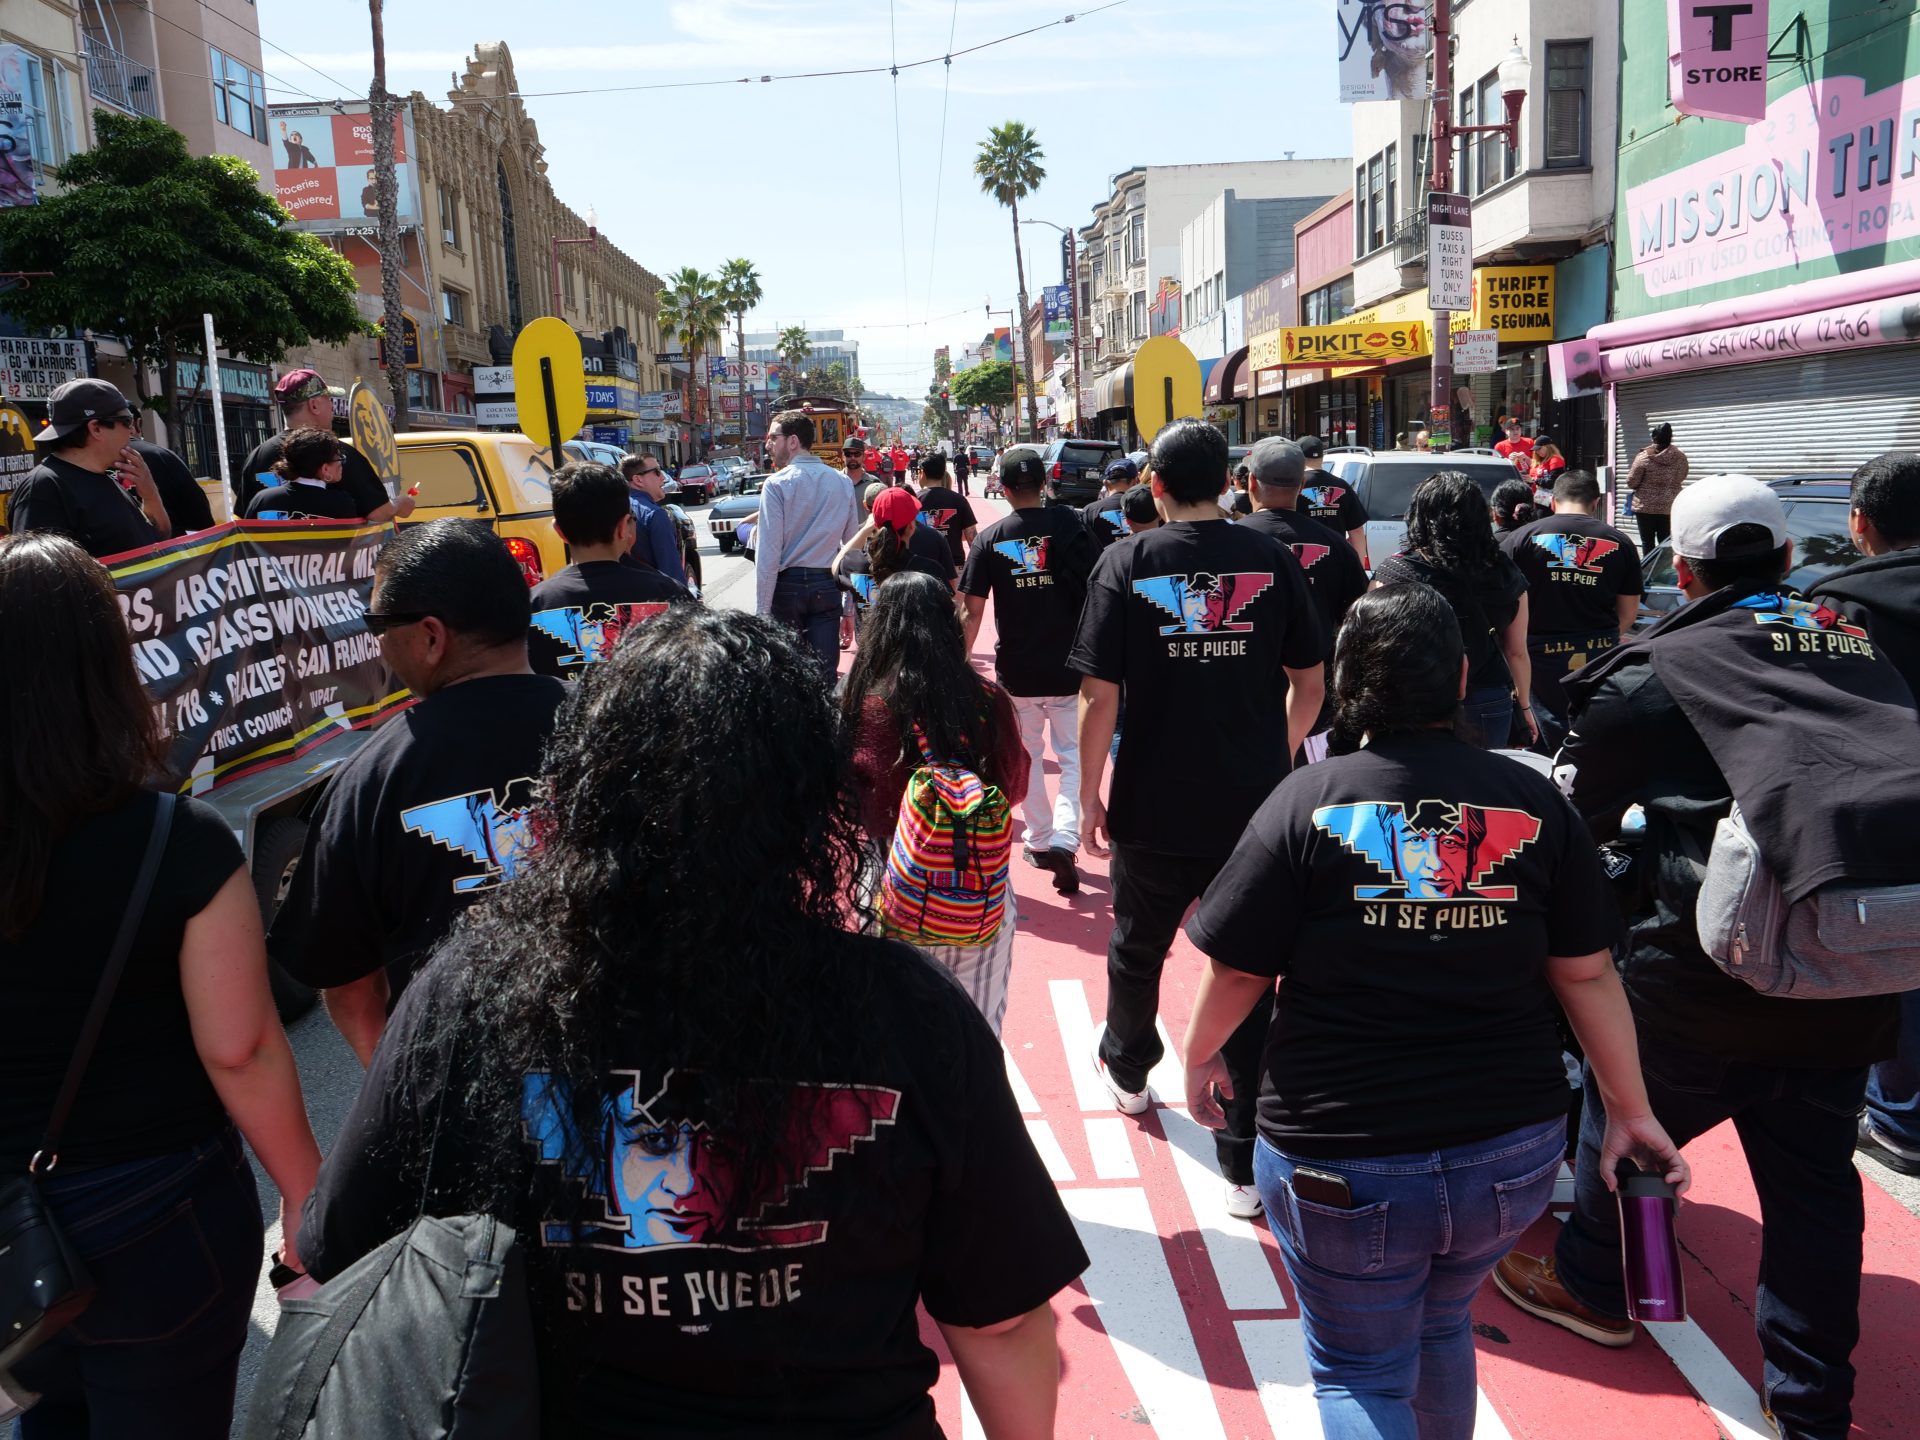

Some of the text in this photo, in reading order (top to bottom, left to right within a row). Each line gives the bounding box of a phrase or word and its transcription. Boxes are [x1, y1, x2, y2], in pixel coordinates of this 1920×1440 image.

[1687, 66, 1762, 84] STORE
[285, 195, 334, 211] Delivered.
[1432, 204, 1469, 217] RIGHT LANE
[1640, 150, 1809, 257] MISSION
[1440, 230, 1463, 242] BUSES
[1438, 243, 1466, 255] TAXIS &
[1651, 253, 1705, 288] QUALITY
[1711, 244, 1748, 271] USED
[1858, 202, 1914, 235] ROPA
[1441, 256, 1463, 267] RIGHT
[1441, 269, 1464, 280] TURNS
[1443, 282, 1462, 292] ONLY
[1486, 275, 1549, 292] THRIFT
[1431, 294, 1470, 306] AT ALL TIMES
[1488, 292, 1549, 309] STORE
[1490, 312, 1552, 330] SEGUNDA
[1454, 332, 1496, 345] NO PARKING
[1624, 345, 1653, 370] NOW
[1662, 338, 1704, 362] EVERY
[1708, 324, 1801, 356] SATURDAY
[1855, 309, 1871, 338] 6
[14, 370, 45, 384] SHOTS
[49, 371, 67, 384] FOR
[590, 391, 595, 402] 7
[595, 391, 615, 403] DAYS
[1015, 578, 1025, 588] SI
[1027, 576, 1037, 587] SE
[1551, 571, 1560, 581] SI
[1561, 571, 1572, 582] SE
[175, 552, 346, 623] ARCHITECTURAL
[186, 588, 366, 667] GLASSWORKERS
[1167, 639, 1247, 658] SI SE PUEDE
[1770, 632, 1876, 661] SI SE PUEDE
[176, 688, 209, 733] 718
[297, 643, 331, 680] SAN
[202, 723, 244, 755] TRICT
[1363, 903, 1509, 930] SI SE PUEDE
[566, 1263, 803, 1317] SI SE PUEDE
